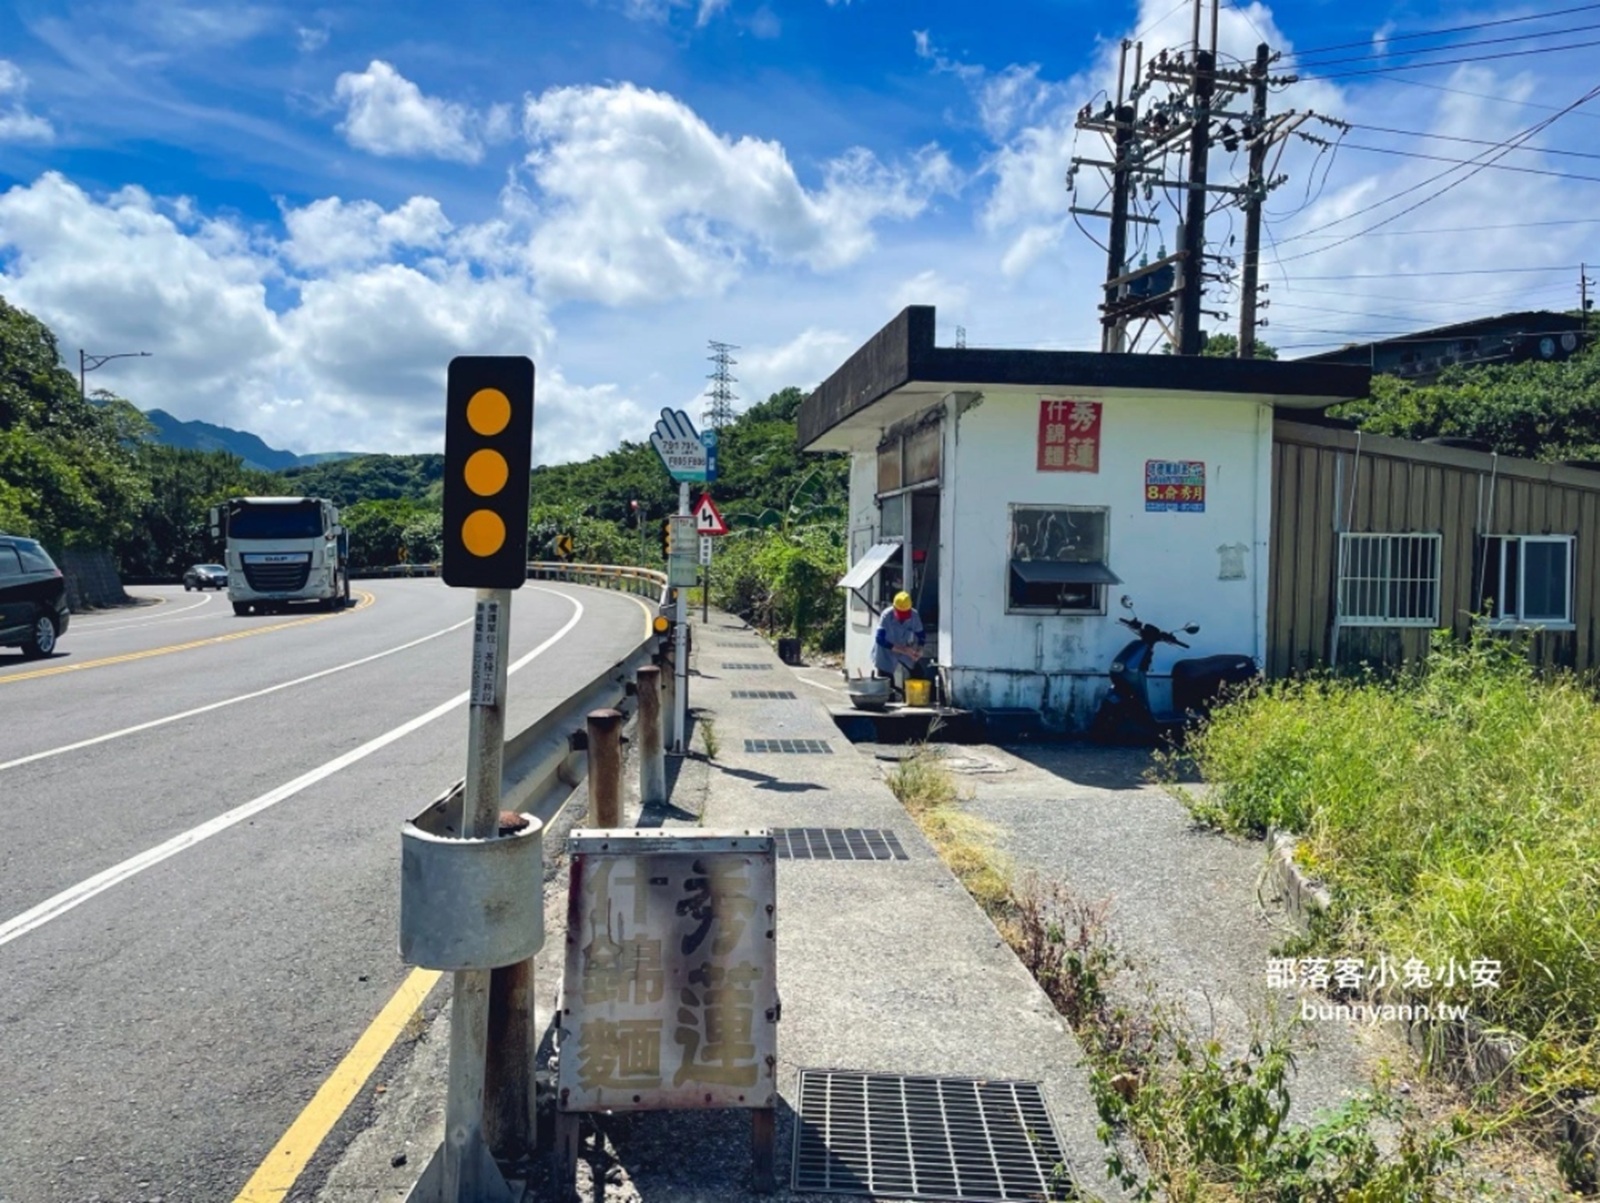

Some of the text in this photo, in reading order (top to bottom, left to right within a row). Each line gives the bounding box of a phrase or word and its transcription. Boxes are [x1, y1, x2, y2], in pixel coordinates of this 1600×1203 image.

[1044, 400, 1067, 466] 什錦麵
[1067, 401, 1096, 467] 秀蓮
[577, 858, 669, 1092] 什錦麵
